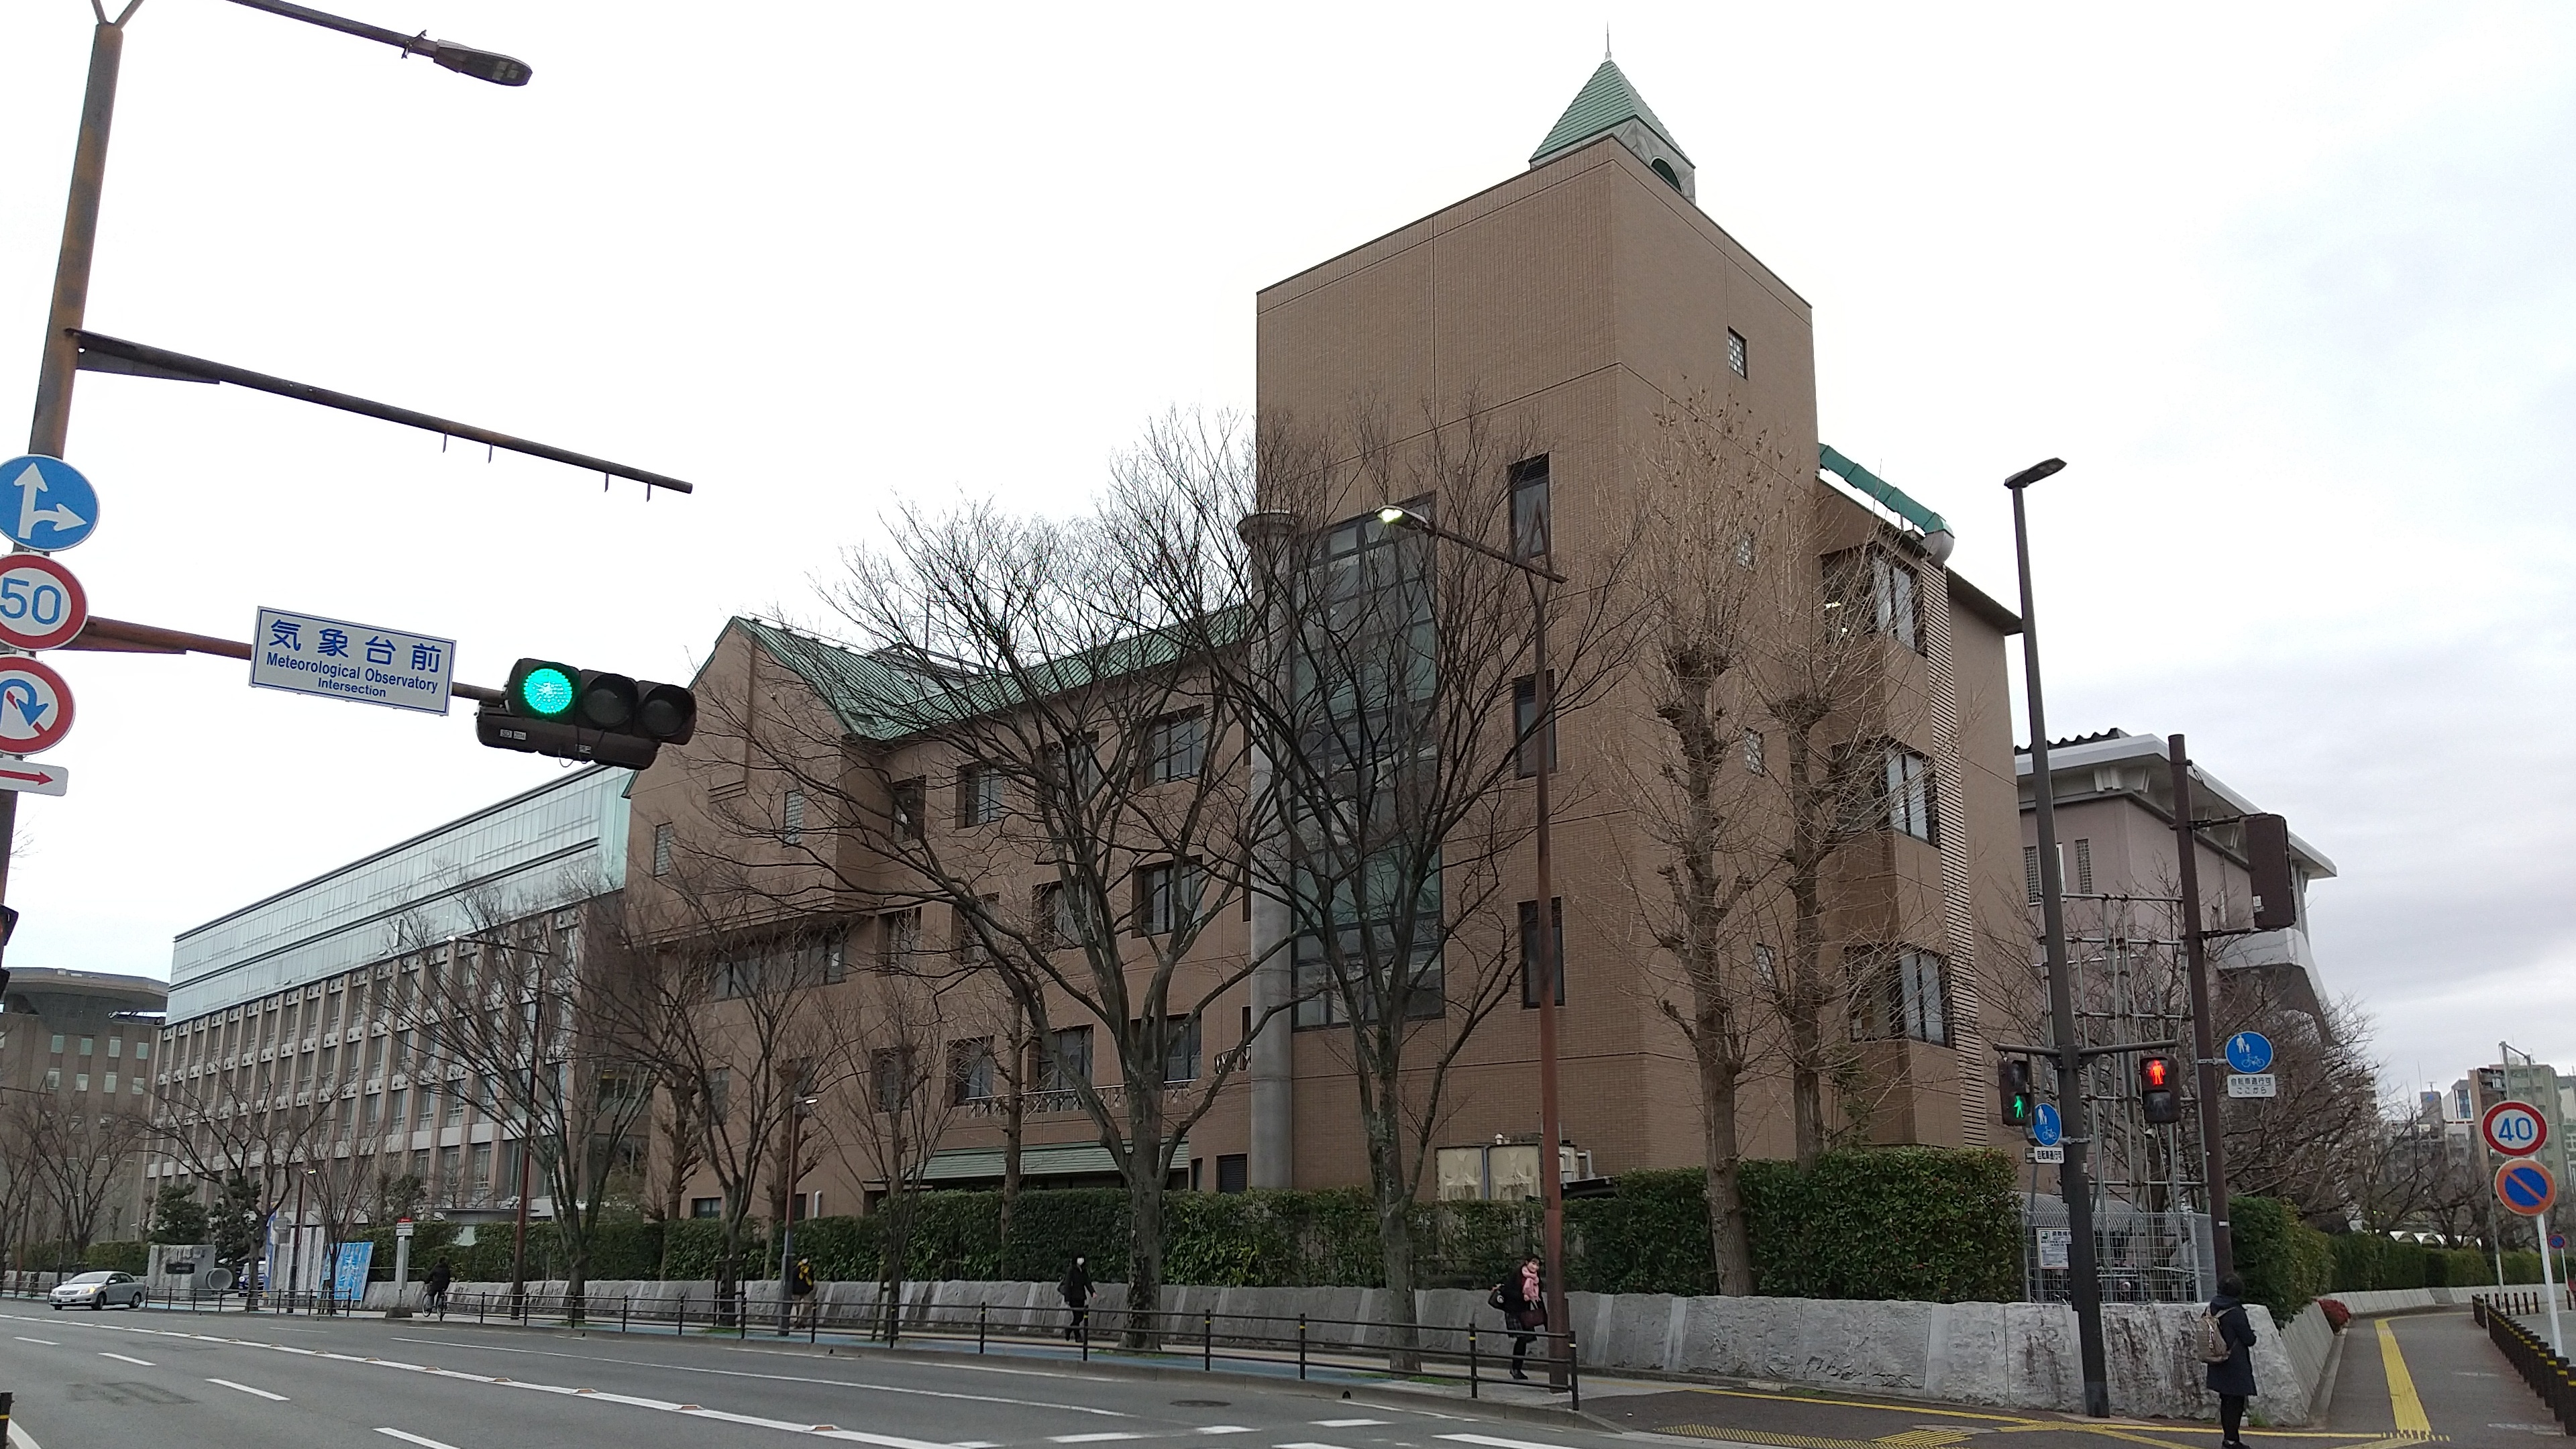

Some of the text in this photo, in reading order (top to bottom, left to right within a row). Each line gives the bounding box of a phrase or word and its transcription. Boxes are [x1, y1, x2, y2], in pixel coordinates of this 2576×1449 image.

[0, 577, 62, 625] 50
[269, 619, 442, 673] 気象台前
[266, 651, 438, 694] Meteorological Observatory
[318, 678, 386, 698] Intersection
[2237, 1087, 2267, 1095] ここから
[2498, 1117, 2533, 1142] 40
